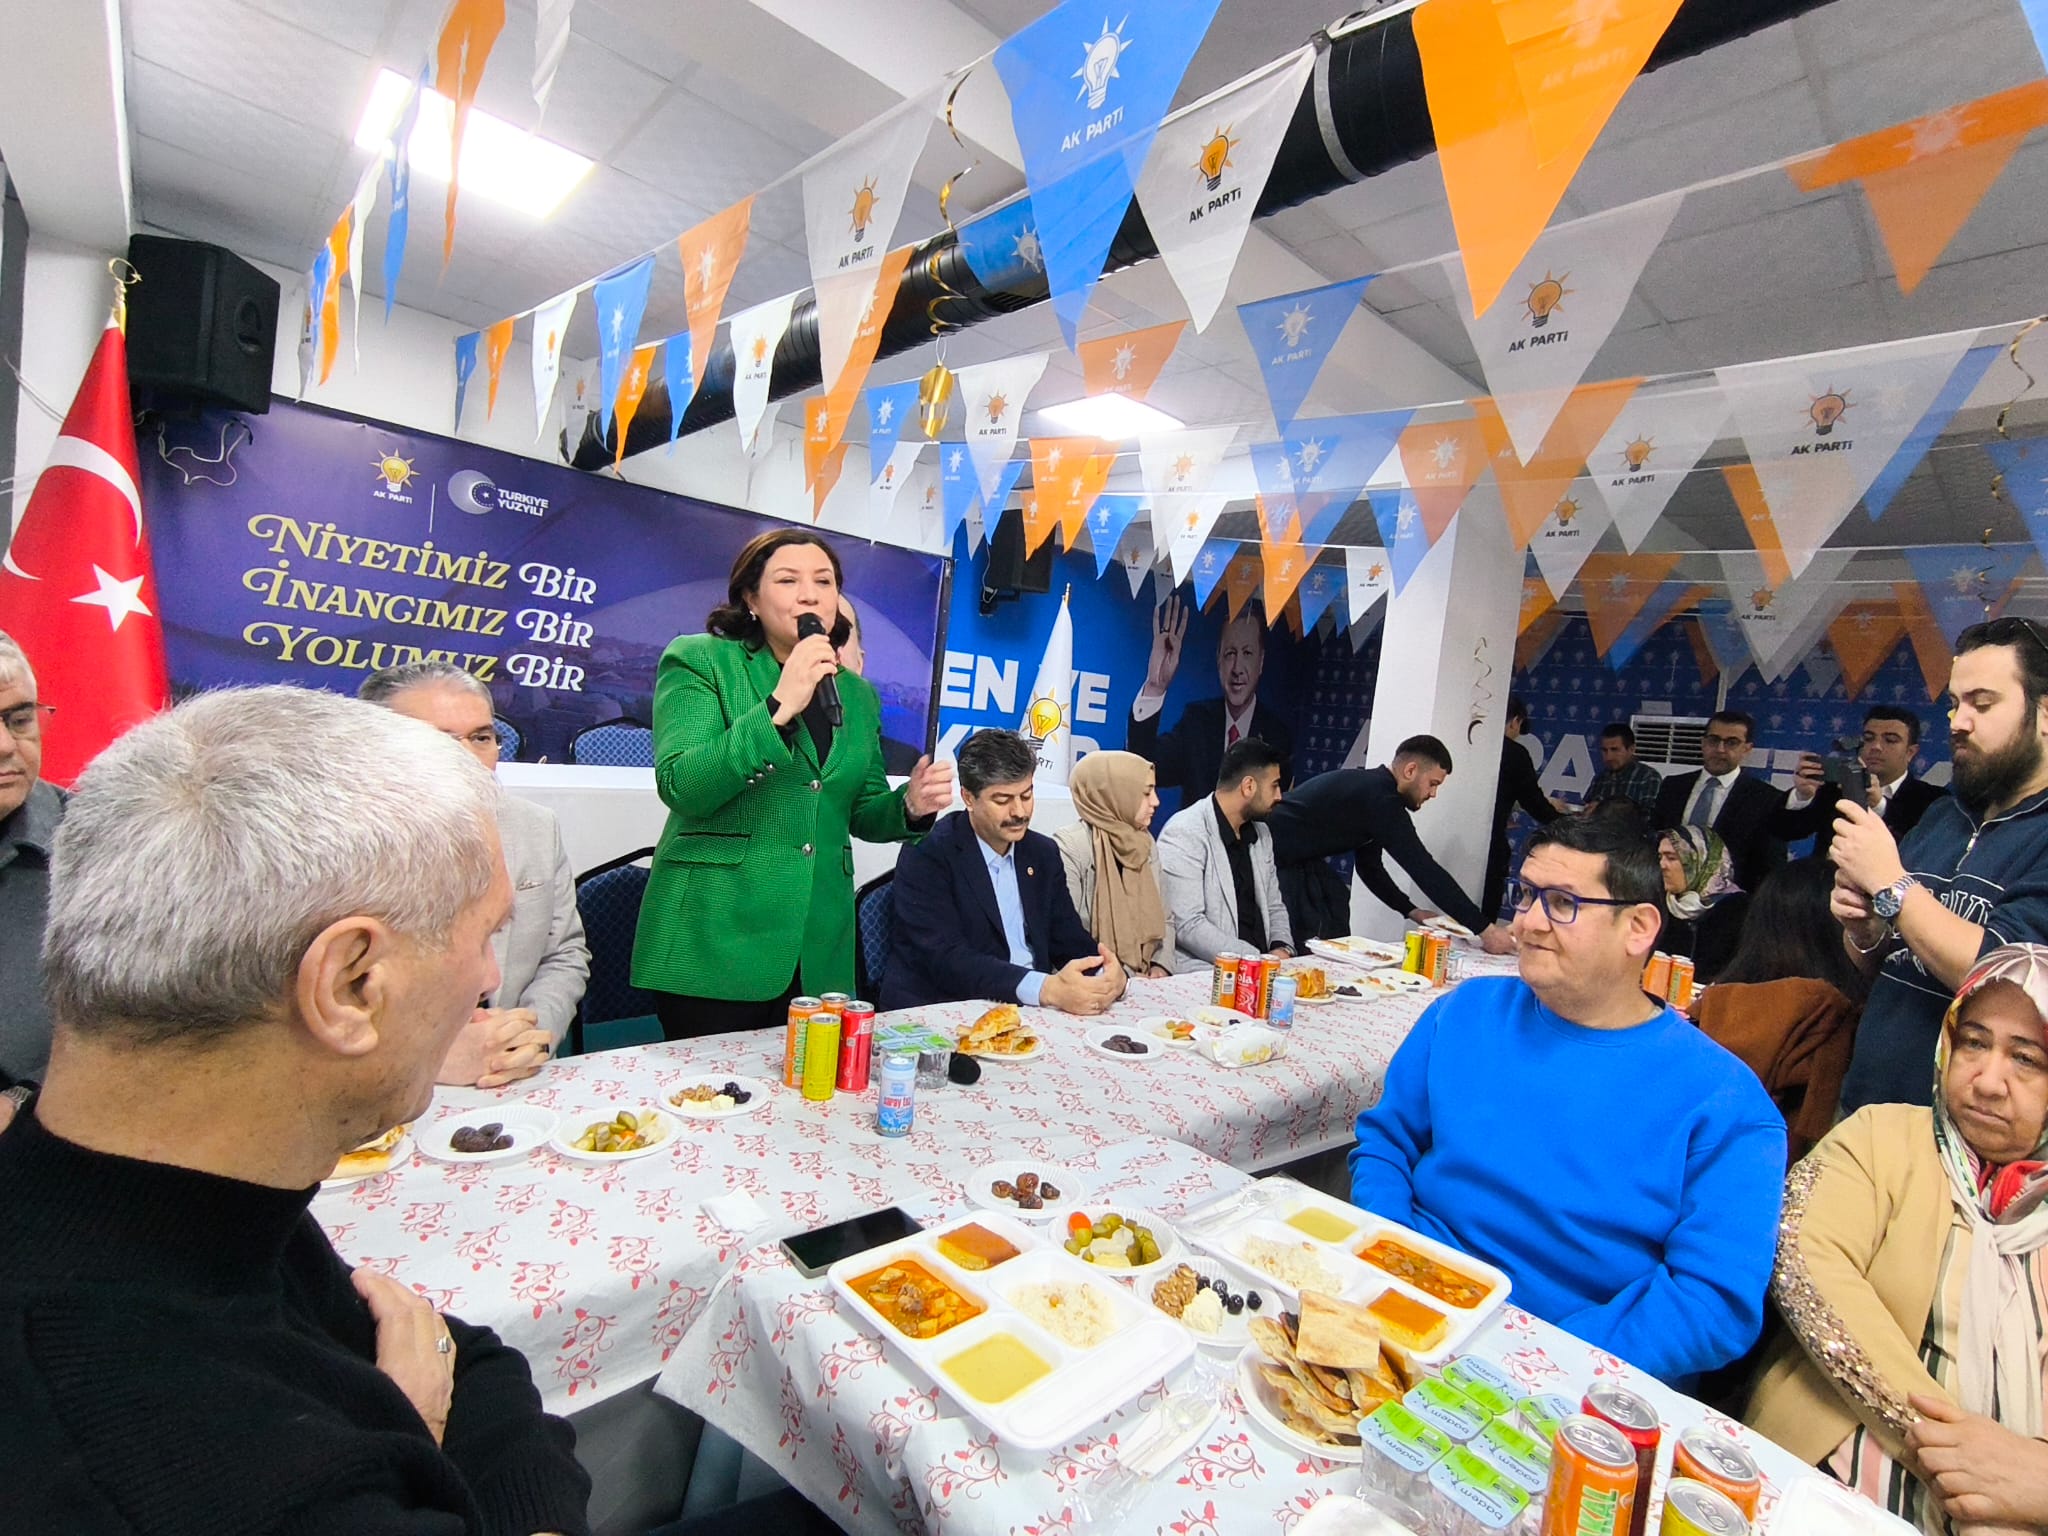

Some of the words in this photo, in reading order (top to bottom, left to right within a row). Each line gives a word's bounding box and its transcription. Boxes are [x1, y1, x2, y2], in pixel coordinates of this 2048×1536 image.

[518, 562, 598, 604] BİR
[515, 608, 594, 648] BİR
[506, 653, 586, 692] BİR
